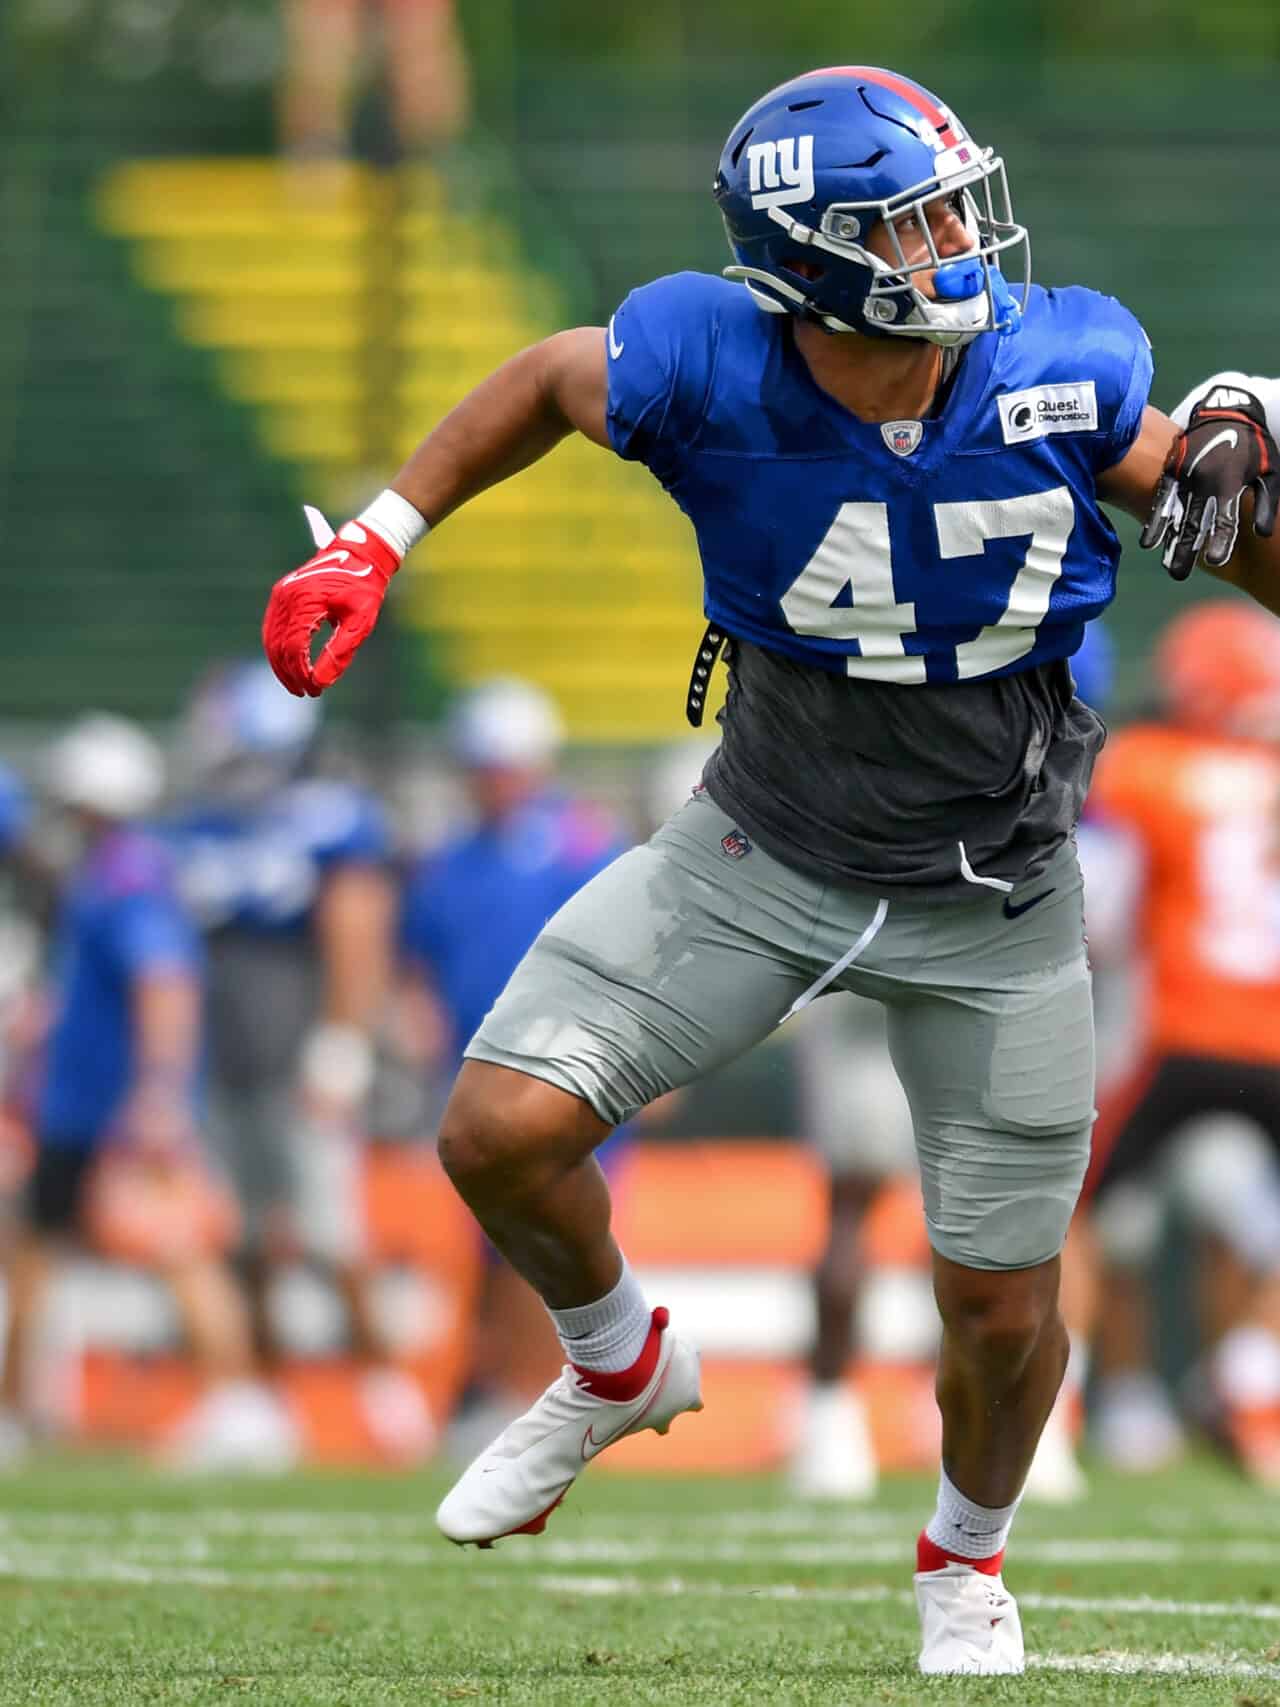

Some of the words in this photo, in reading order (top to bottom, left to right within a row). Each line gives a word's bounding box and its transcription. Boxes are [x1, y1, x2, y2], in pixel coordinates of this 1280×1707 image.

[1037, 399, 1079, 412] Quest
[1038, 412, 1090, 422] Diagnostics
[779, 485, 1075, 685] 47
